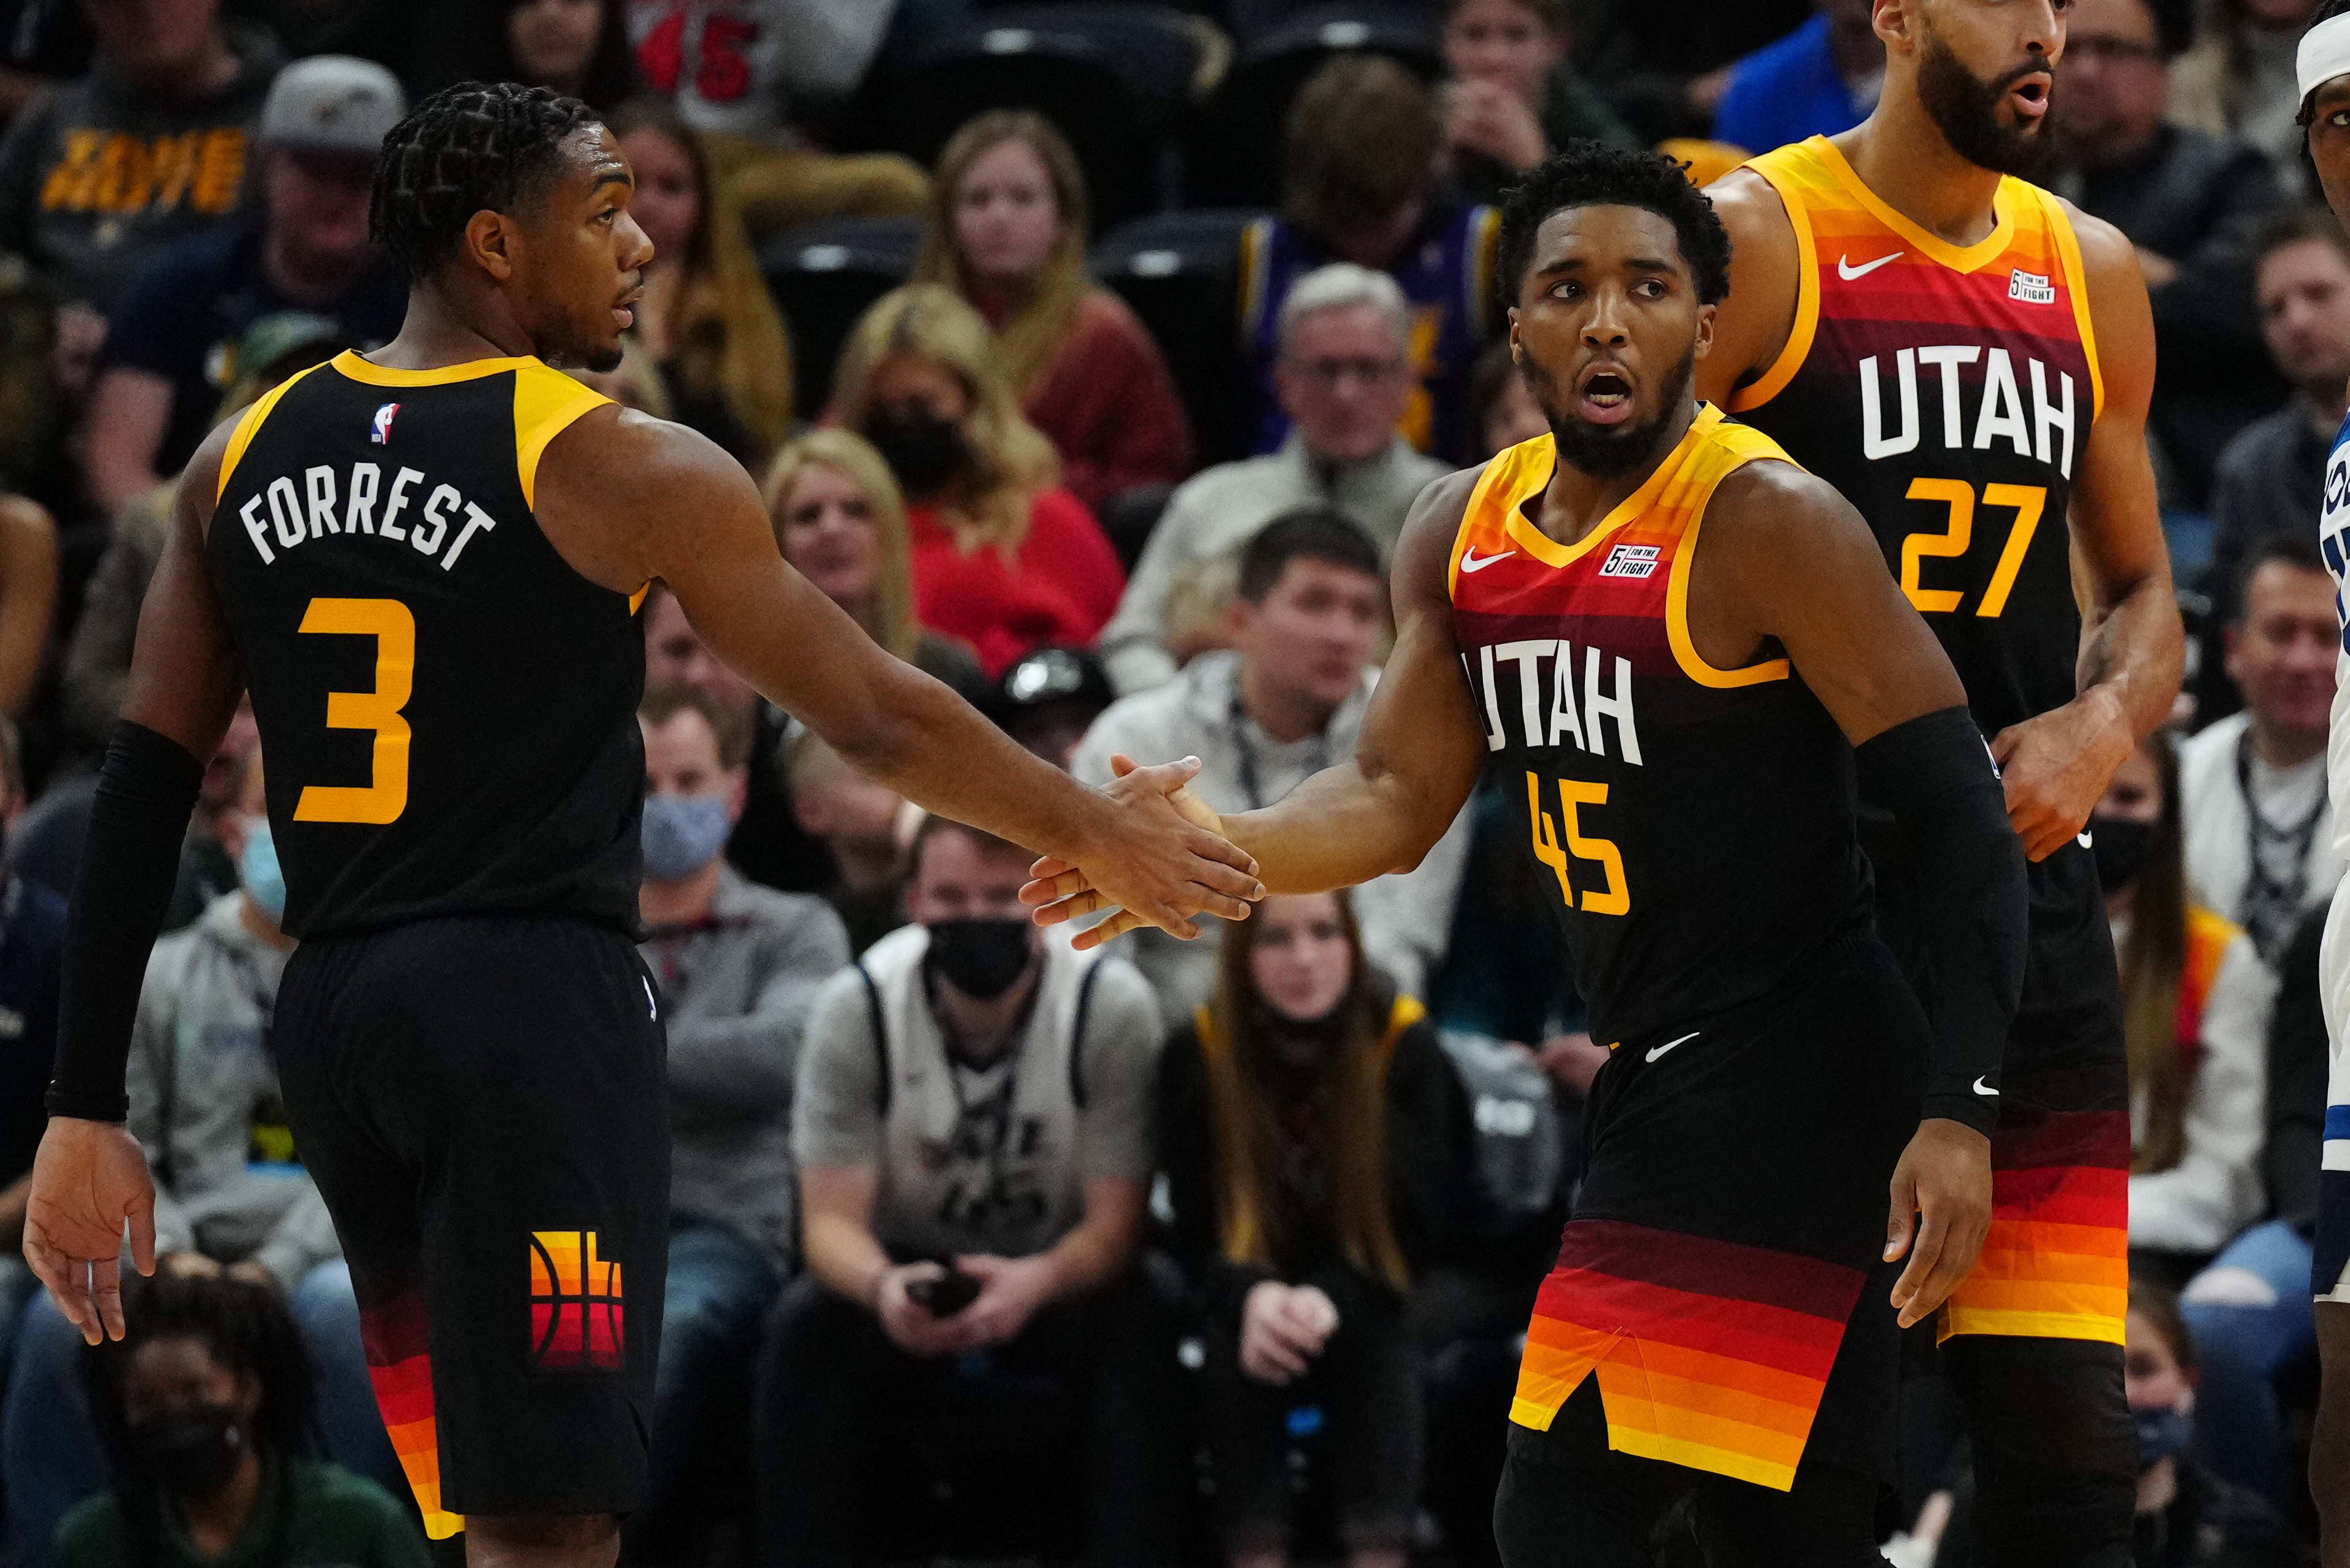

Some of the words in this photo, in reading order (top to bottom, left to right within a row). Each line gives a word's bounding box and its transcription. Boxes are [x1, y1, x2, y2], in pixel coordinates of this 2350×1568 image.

[2011, 272, 2020, 296] 5
[2024, 288, 2051, 300] FIGHT
[1859, 345, 2075, 480] UTAH
[239, 462, 496, 572] FORREST
[1605, 548, 1627, 573] 5
[1619, 562, 1653, 575] FIGHT
[1900, 477, 2048, 618] 27
[293, 597, 415, 825] 3
[1526, 770, 1630, 916] 45
